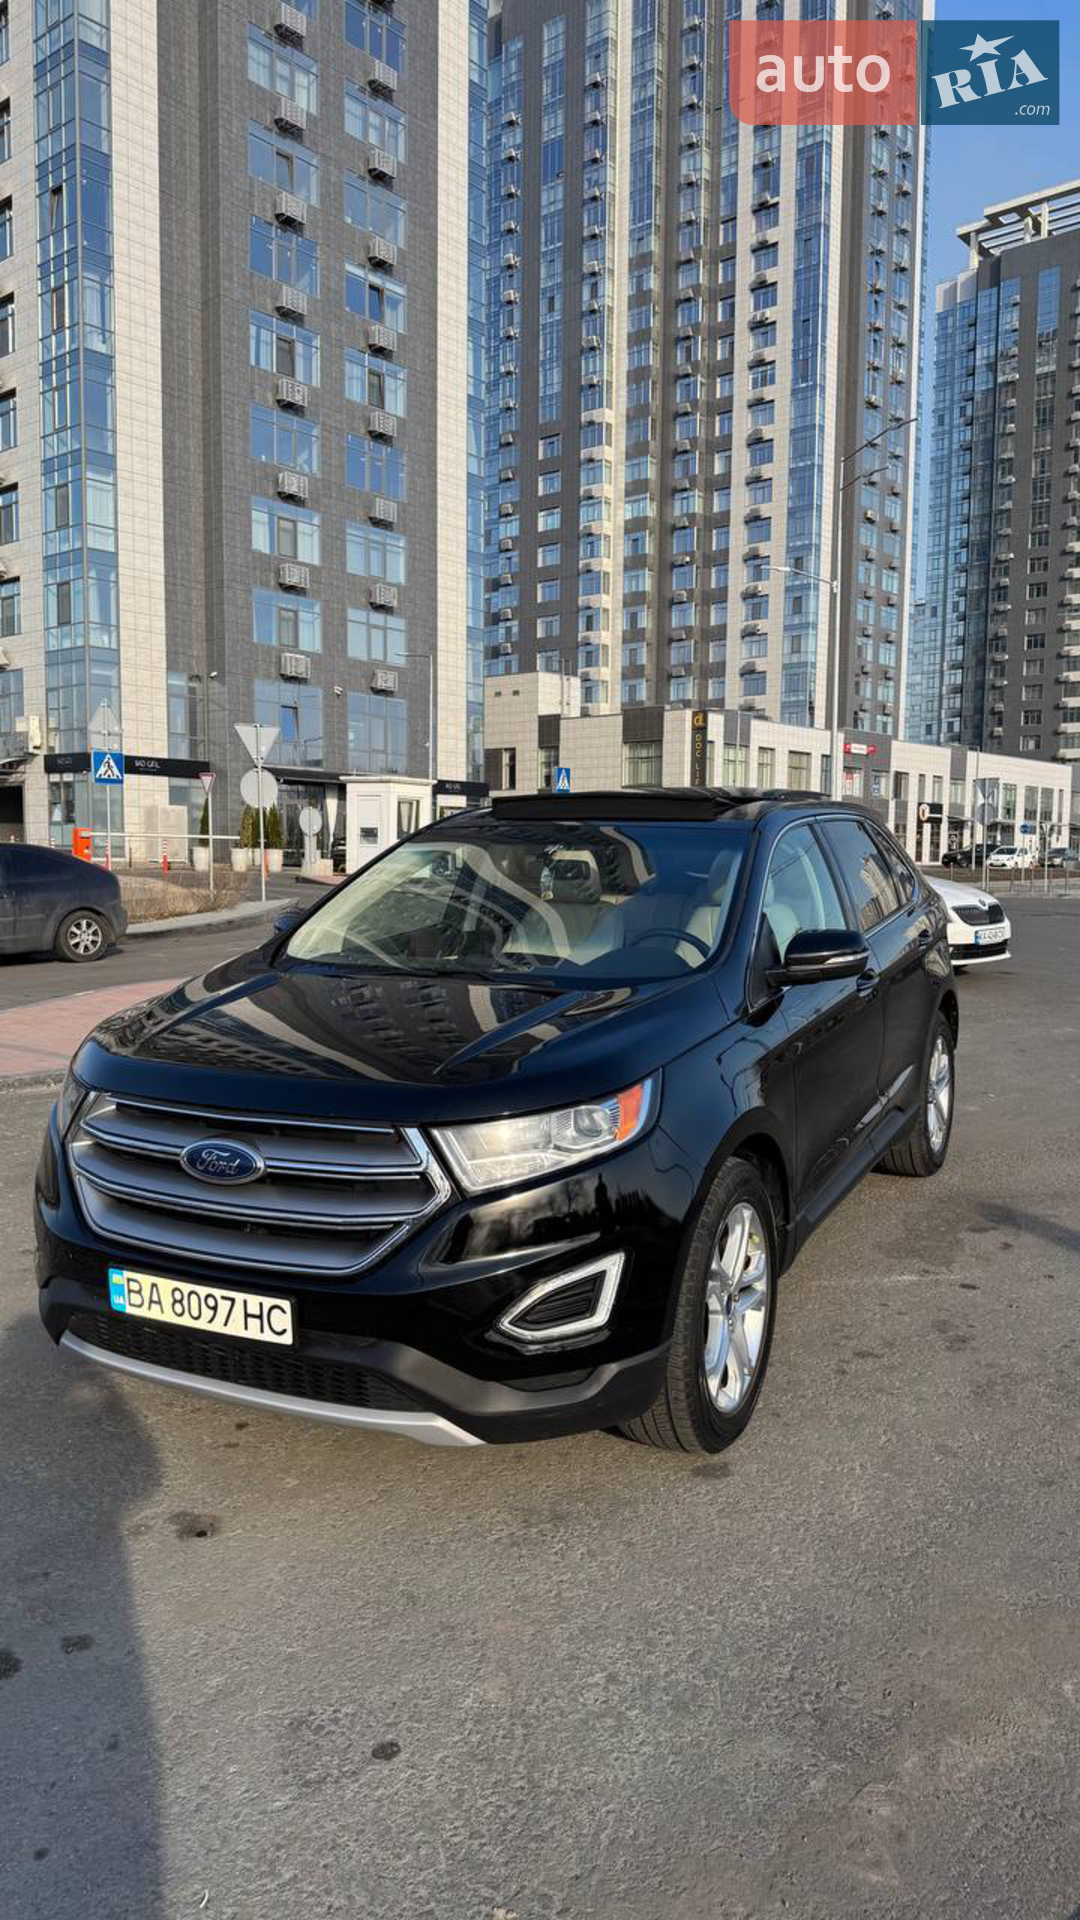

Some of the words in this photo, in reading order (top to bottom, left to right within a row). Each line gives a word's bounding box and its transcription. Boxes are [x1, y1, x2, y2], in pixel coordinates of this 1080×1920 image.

[196, 1149, 241, 1175] Ford
[126, 1277, 164, 1315] BA
[171, 1287, 236, 1327] 8097
[243, 1299, 288, 1337] HC
